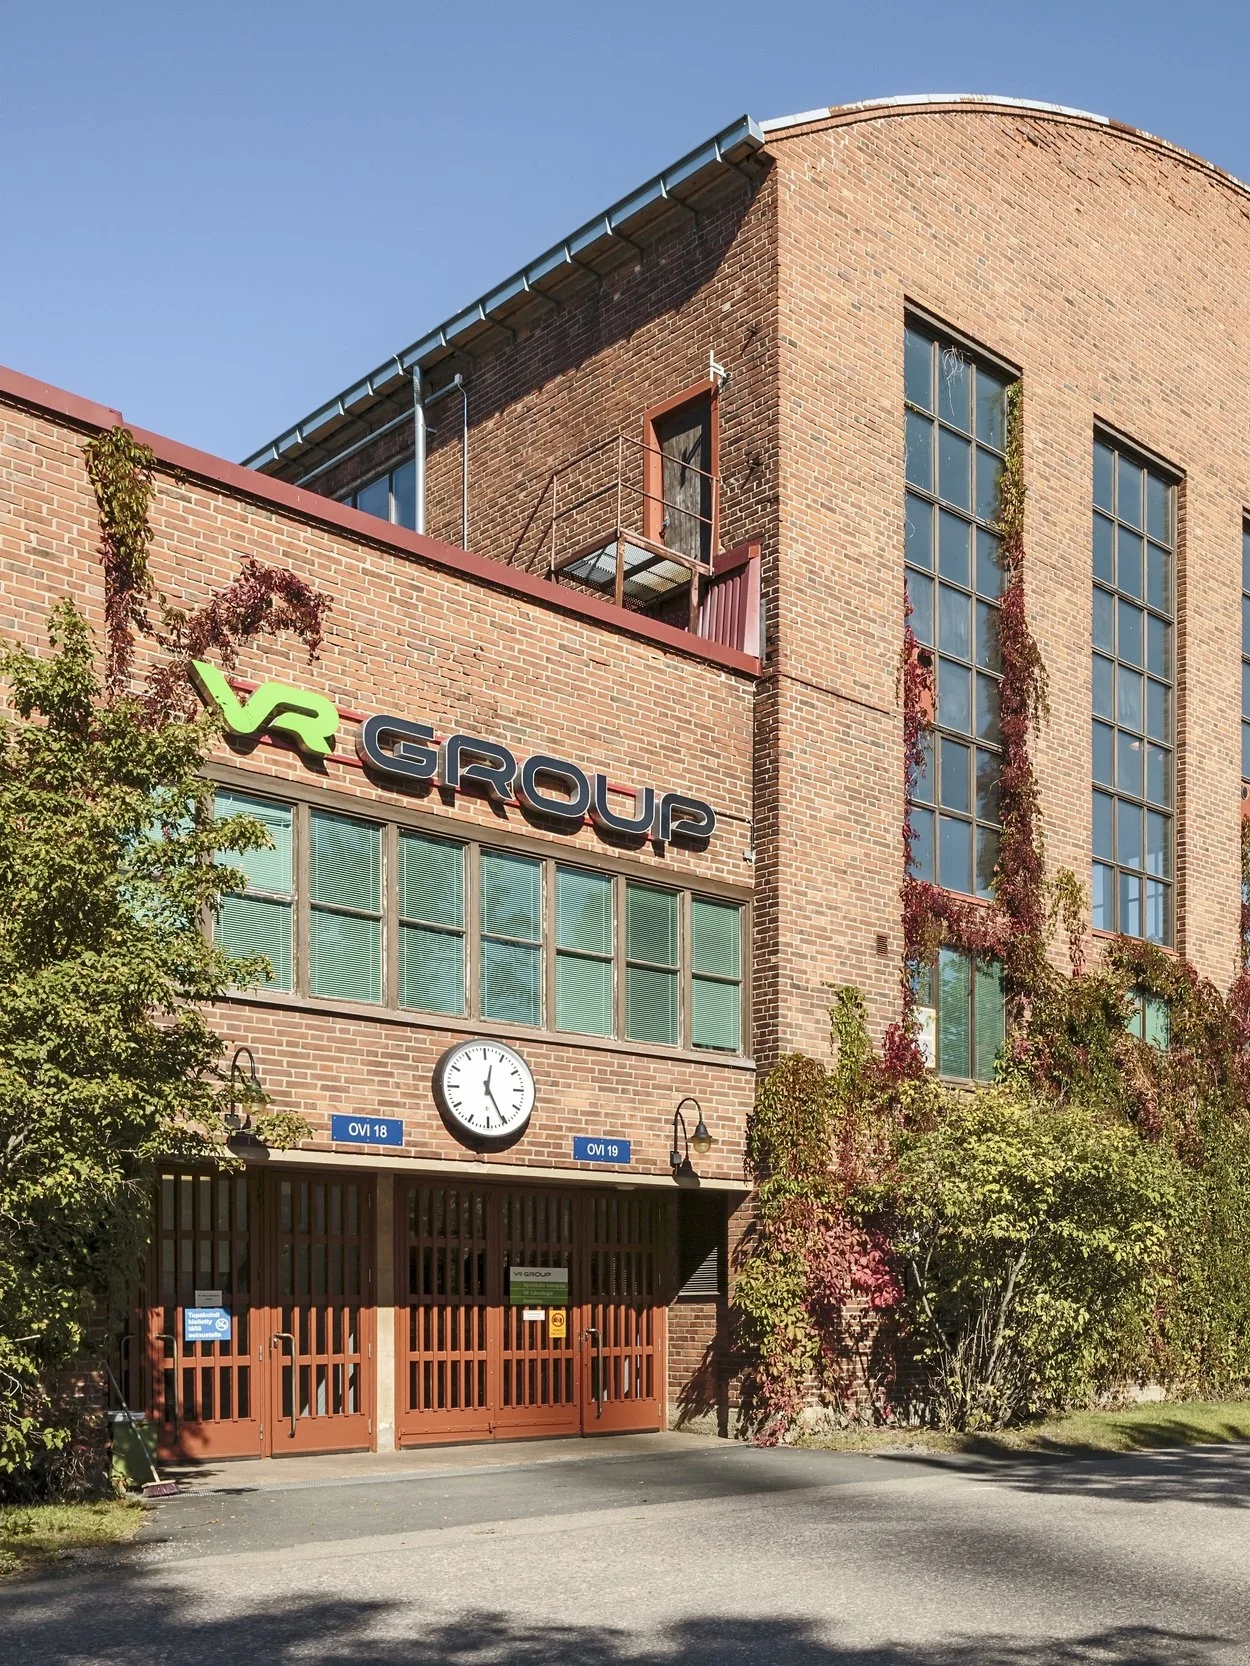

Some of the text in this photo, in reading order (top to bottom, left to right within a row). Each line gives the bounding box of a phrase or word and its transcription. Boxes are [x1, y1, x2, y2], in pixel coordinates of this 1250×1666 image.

[192, 659, 718, 842] VR GROUP
[348, 1122, 388, 1138] OVI 18
[587, 1143, 618, 1157] OVI 19
